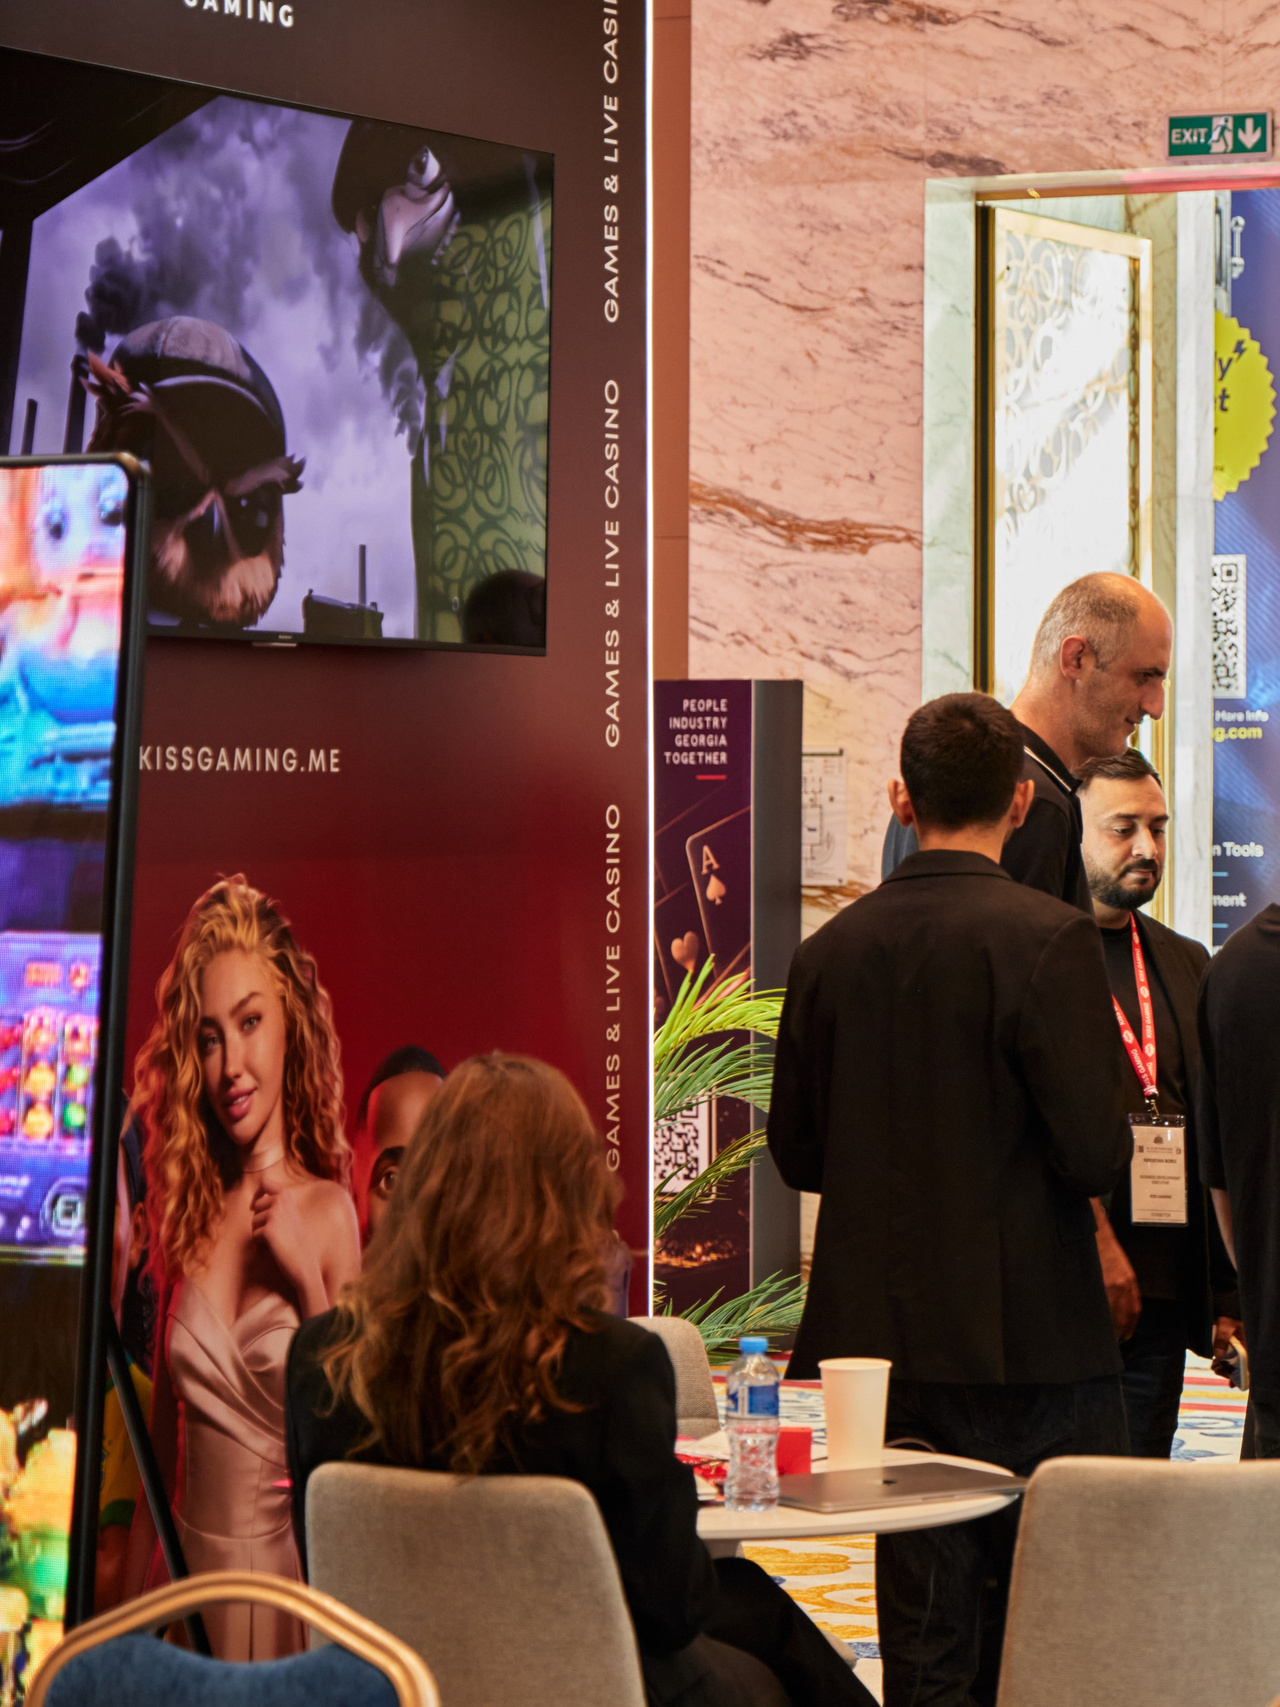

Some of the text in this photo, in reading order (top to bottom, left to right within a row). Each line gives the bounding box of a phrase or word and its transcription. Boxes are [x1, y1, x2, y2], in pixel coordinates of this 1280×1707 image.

[1171, 128, 1208, 144] EXIT
[603, 0, 619, 323] GAMES & LIVE CASI
[604, 379, 620, 748] GAMES & LIVE CASINO
[683, 699, 728, 712] PEOPLE
[669, 717, 728, 729] INDUSTRY
[674, 734, 728, 747] GEORGIA
[1212, 727, 1263, 742] g.com
[139, 746, 340, 772] KISSGAMING.ME
[664, 752, 728, 765] TOGETHER
[1222, 841, 1264, 857] Tools
[701, 845, 720, 875] A
[606, 804, 621, 1172] GAMES & LIVE CASINO
